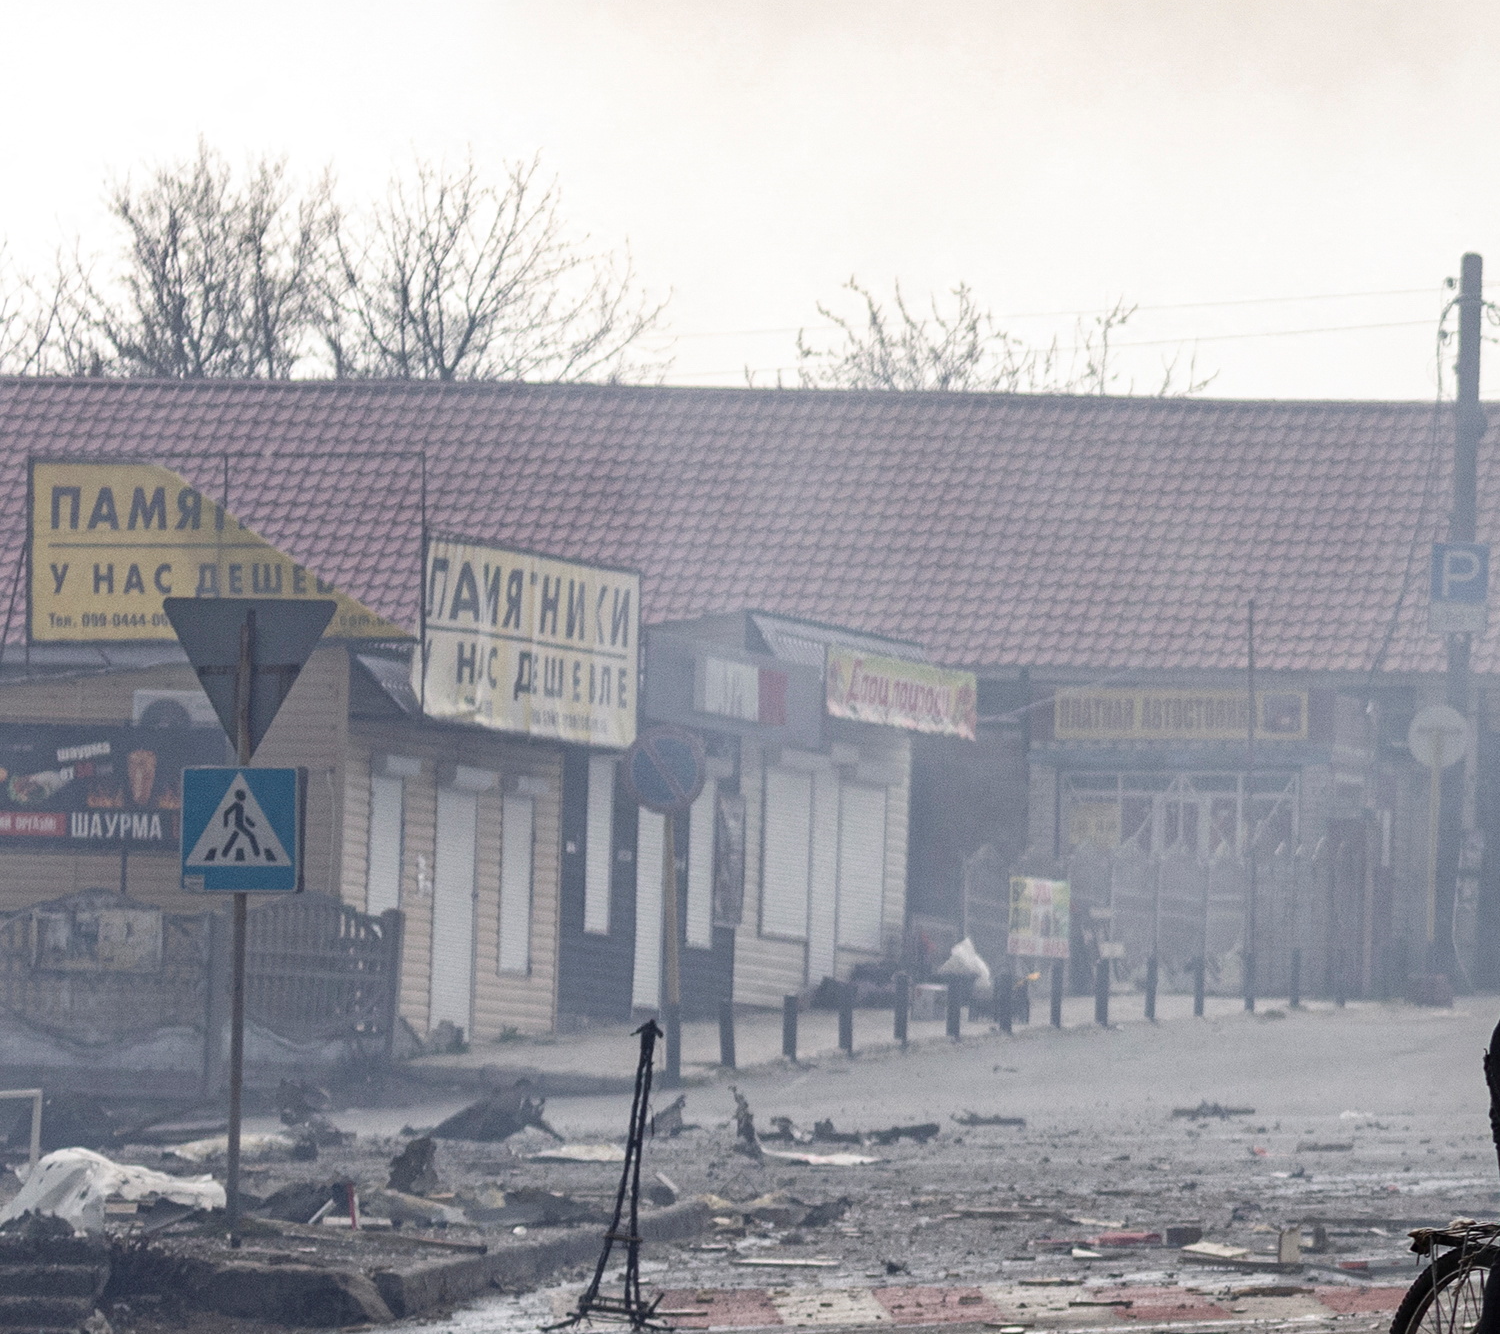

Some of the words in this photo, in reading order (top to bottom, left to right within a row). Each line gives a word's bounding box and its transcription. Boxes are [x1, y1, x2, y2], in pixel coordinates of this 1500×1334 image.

[51, 485, 247, 531] ПАМЯ
[49, 563, 69, 595] У
[92, 563, 173, 595] НАС
[1441, 550, 1480, 597] P
[426, 557, 631, 648] ПАМЯНИКИ
[456, 640, 498, 690] НС
[71, 811, 162, 840] ШАУРМА
